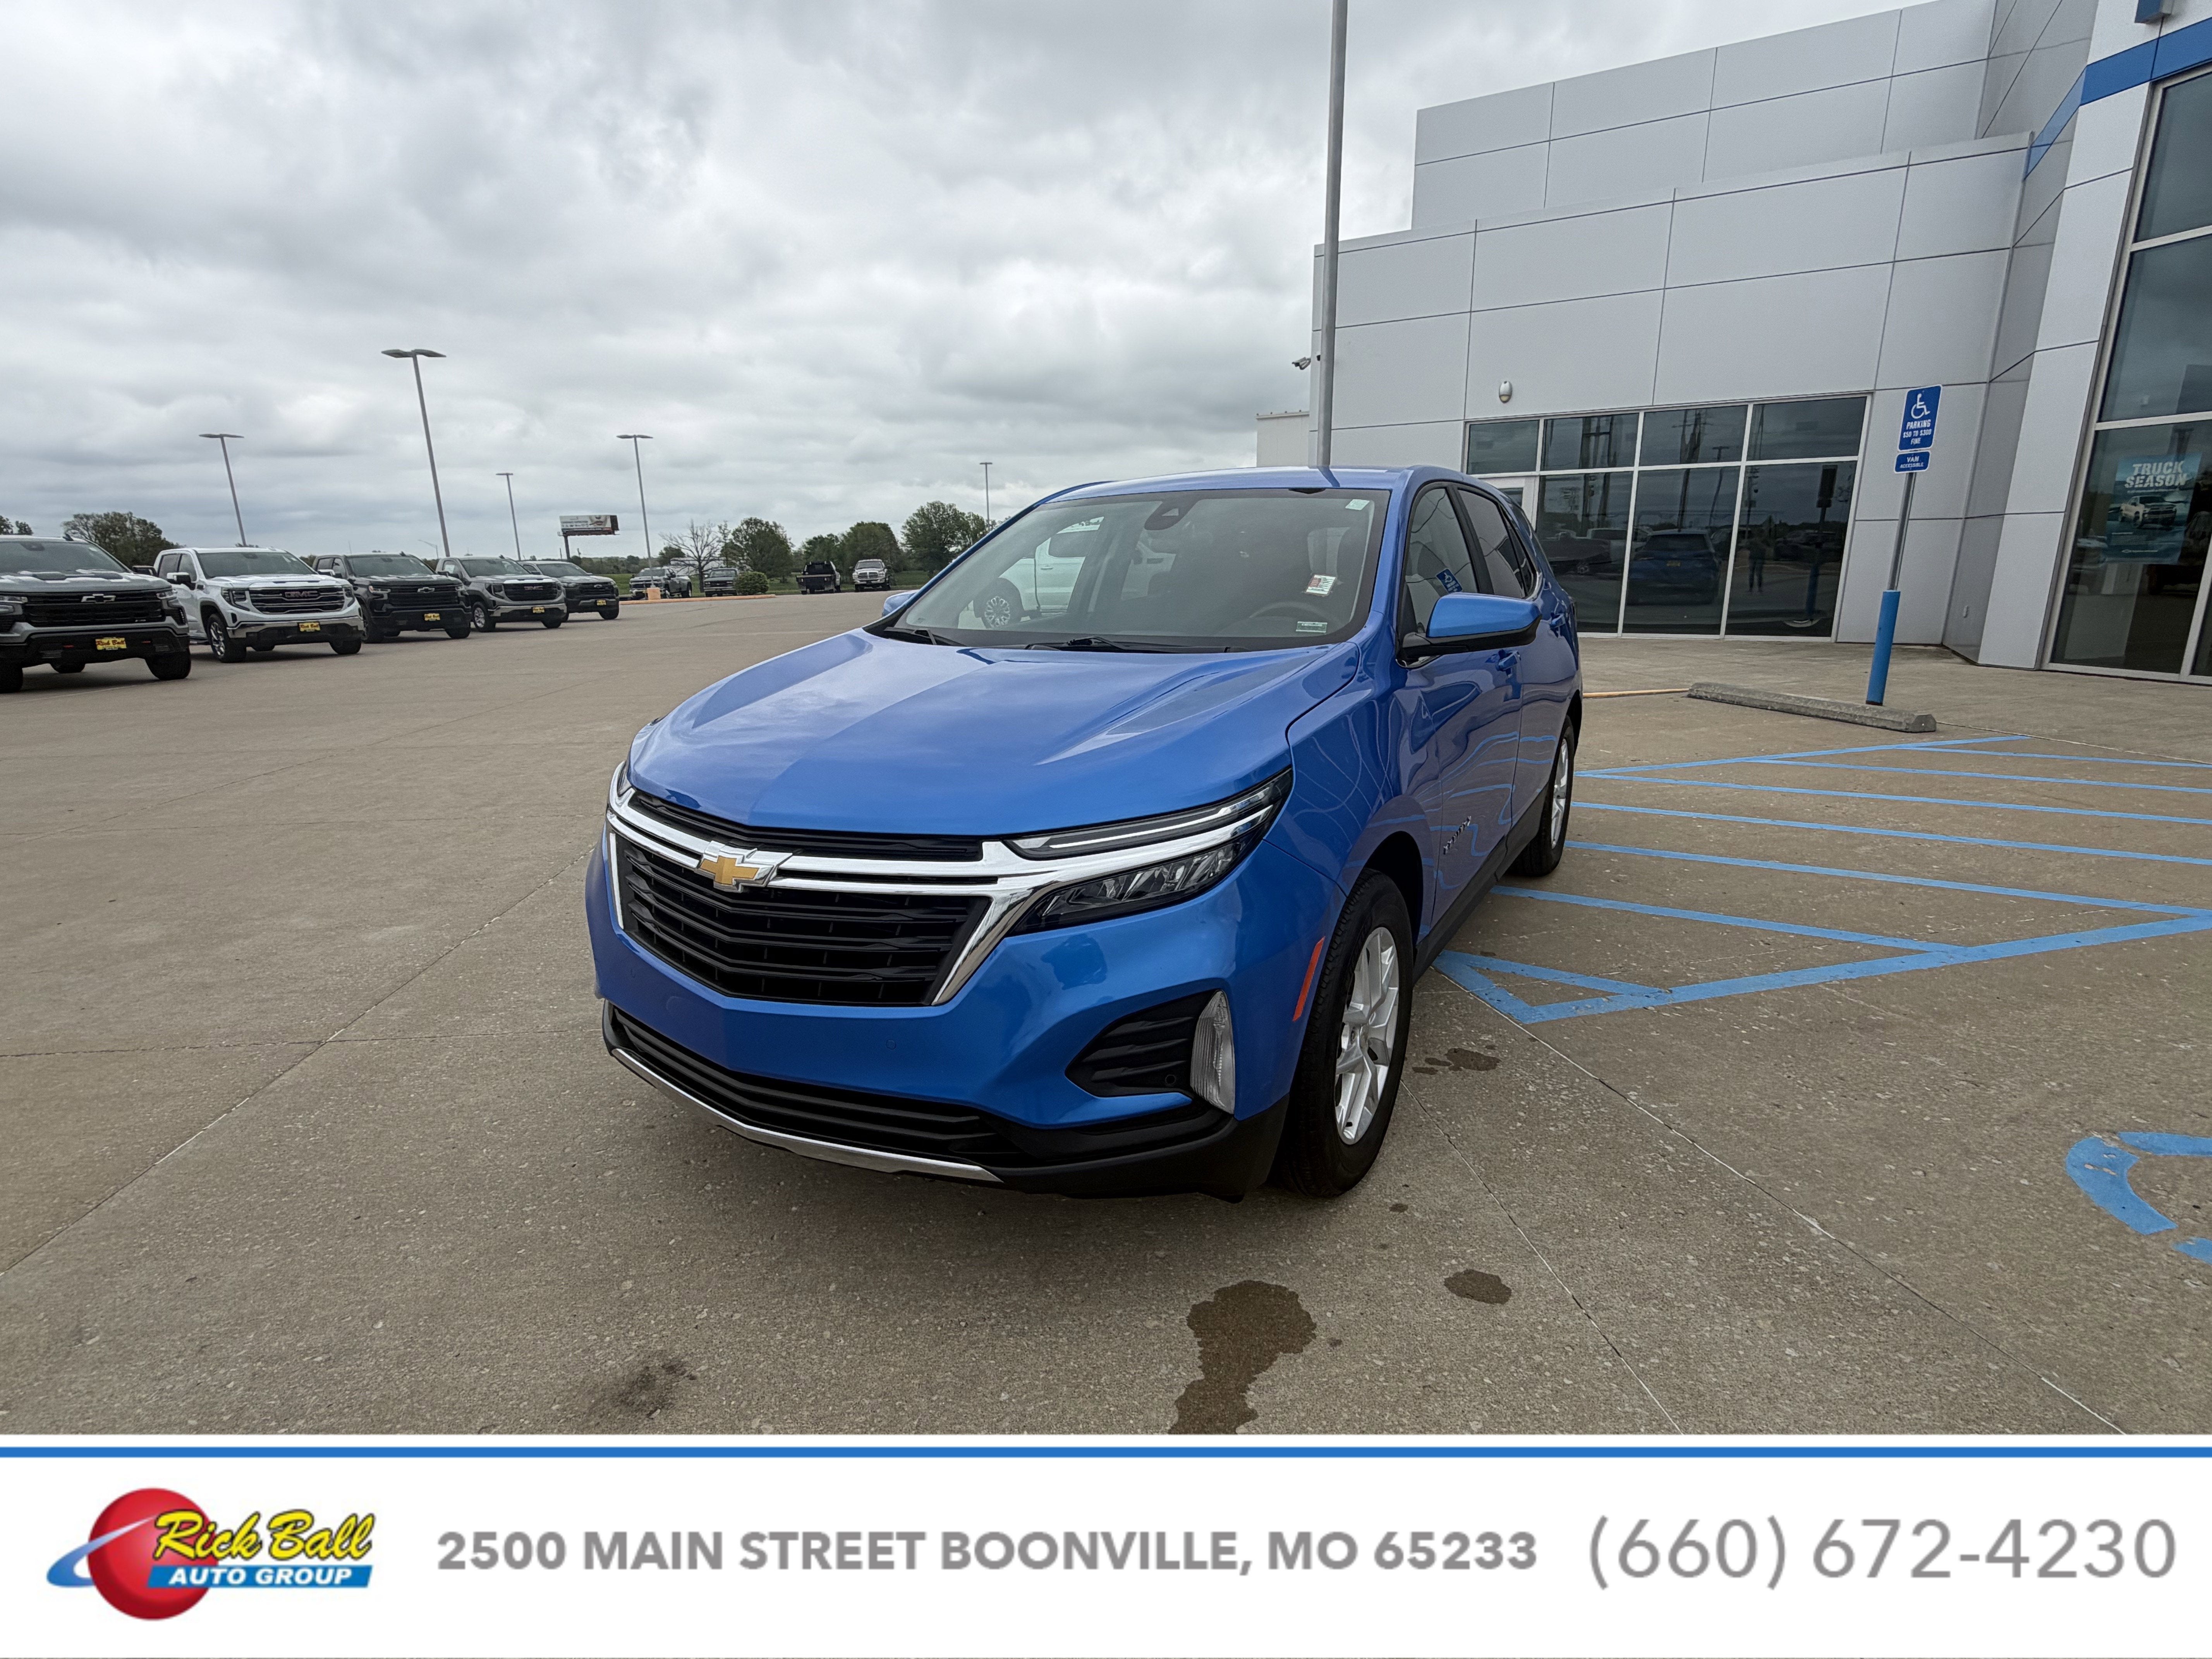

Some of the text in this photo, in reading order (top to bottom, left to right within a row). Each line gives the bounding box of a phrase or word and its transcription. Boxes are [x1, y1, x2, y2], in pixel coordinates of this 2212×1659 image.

[1906, 419, 1931, 430] PARKING
[2132, 460, 2184, 476] TRUCK
[2124, 473, 2188, 488] SEASON
